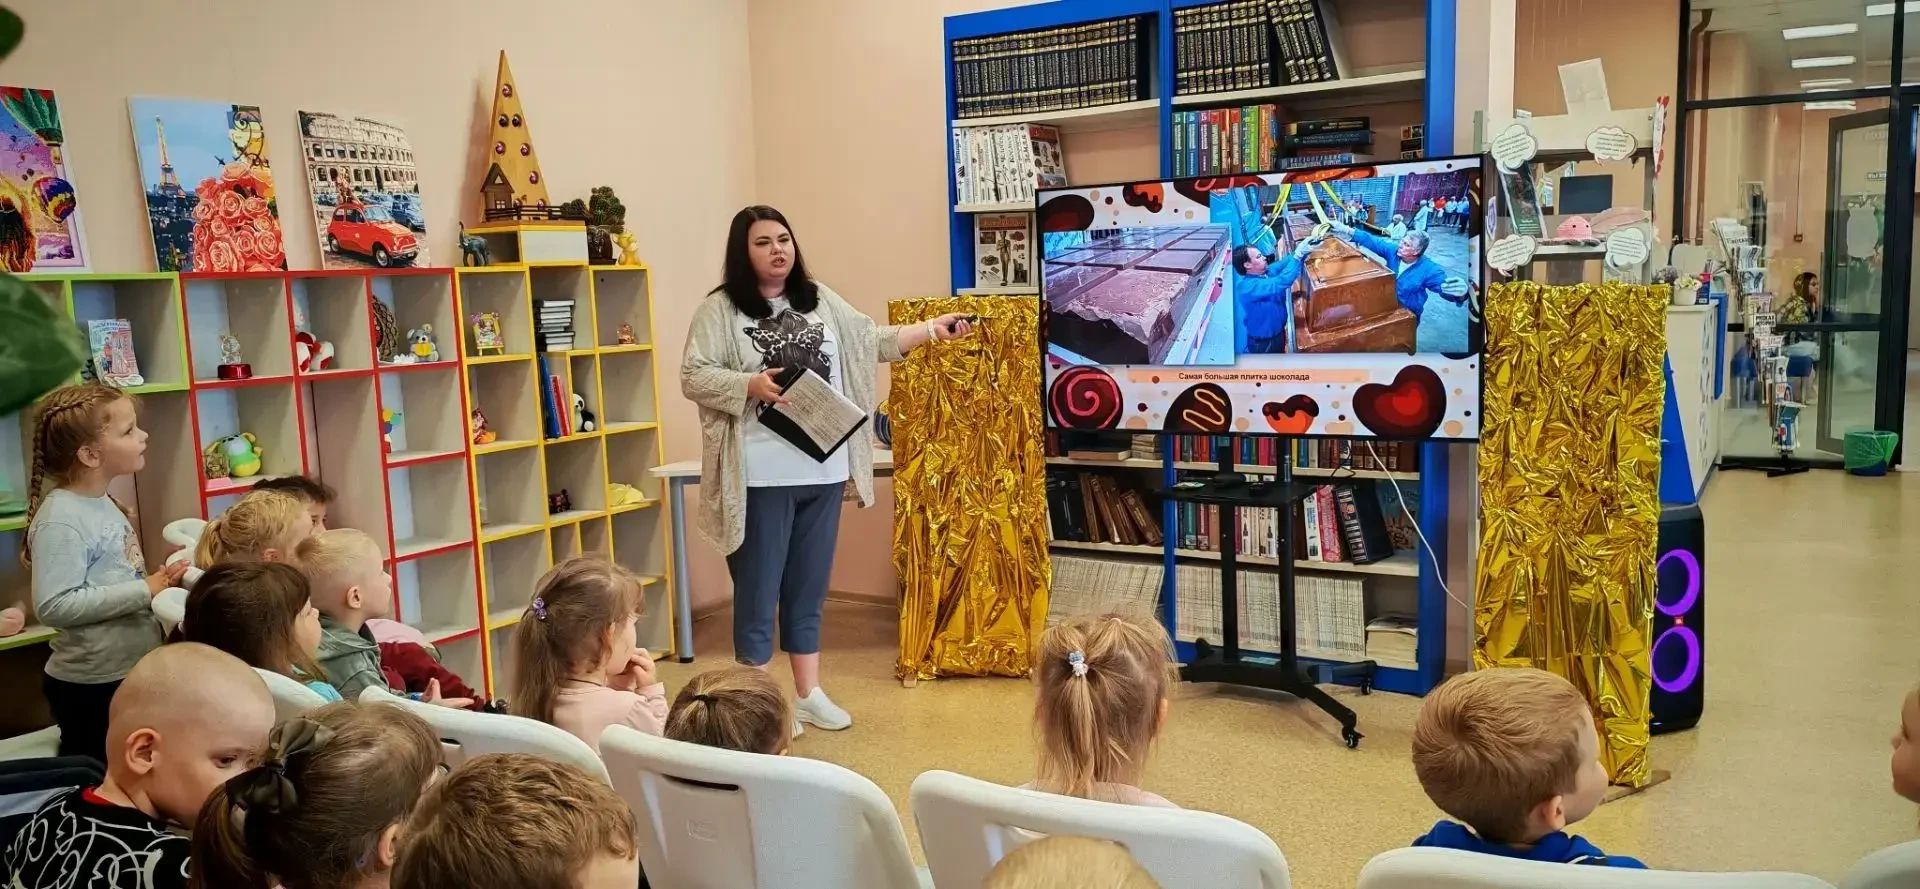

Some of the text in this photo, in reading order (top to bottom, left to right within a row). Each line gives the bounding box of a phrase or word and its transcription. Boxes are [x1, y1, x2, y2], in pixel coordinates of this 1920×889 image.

[1178, 372, 1310, 382] Самая большая плитка шоколада
